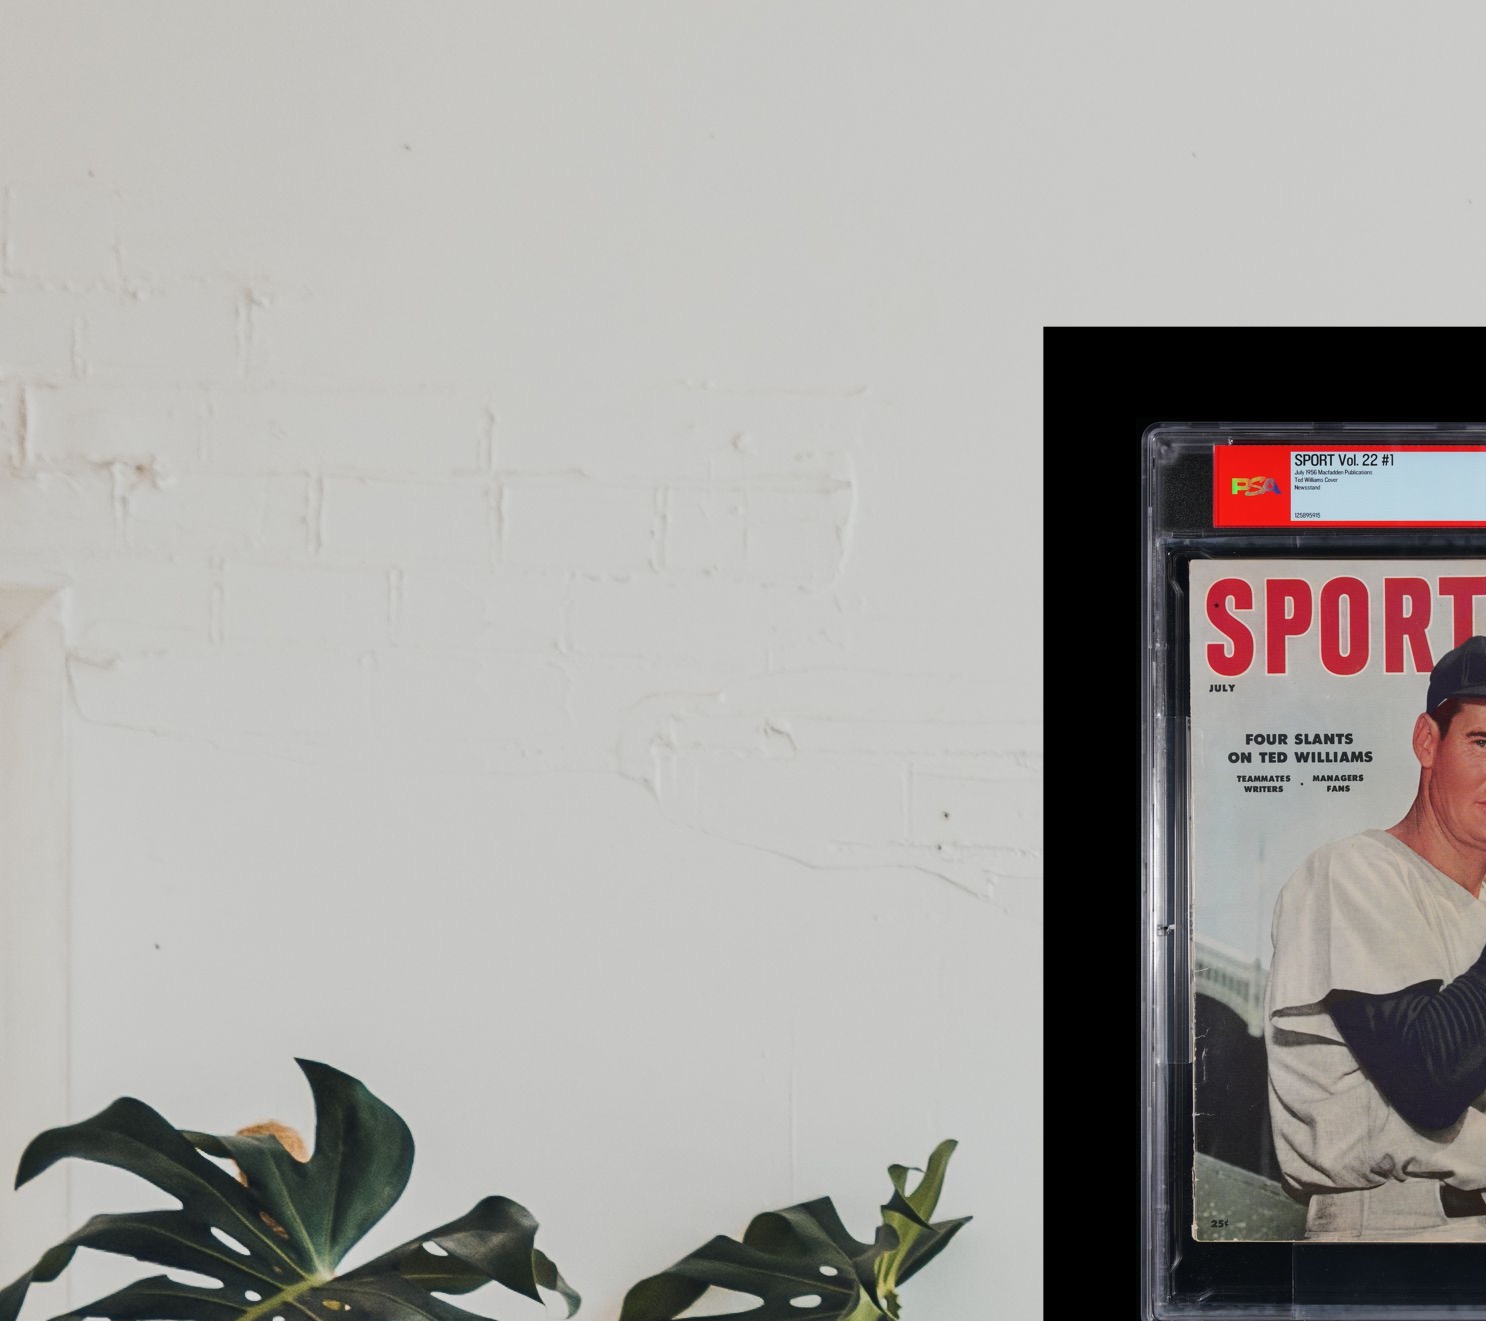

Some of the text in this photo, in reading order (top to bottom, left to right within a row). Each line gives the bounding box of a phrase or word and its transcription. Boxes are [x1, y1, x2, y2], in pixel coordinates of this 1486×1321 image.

[1294, 454, 1394, 467] SPORT Vol. 22 #1
[1231, 475, 1283, 497] PSA
[1208, 683, 1236, 693] JULY
[1245, 733, 1354, 747] FOUR SLANTS
[1227, 750, 1374, 764] ON TED WILLIAMS
[1236, 775, 1292, 784] TEAMMATES
[1312, 773, 1365, 783] MANAGERS
[1243, 784, 1284, 794] WRITERS
[1326, 784, 1351, 793] FANS
